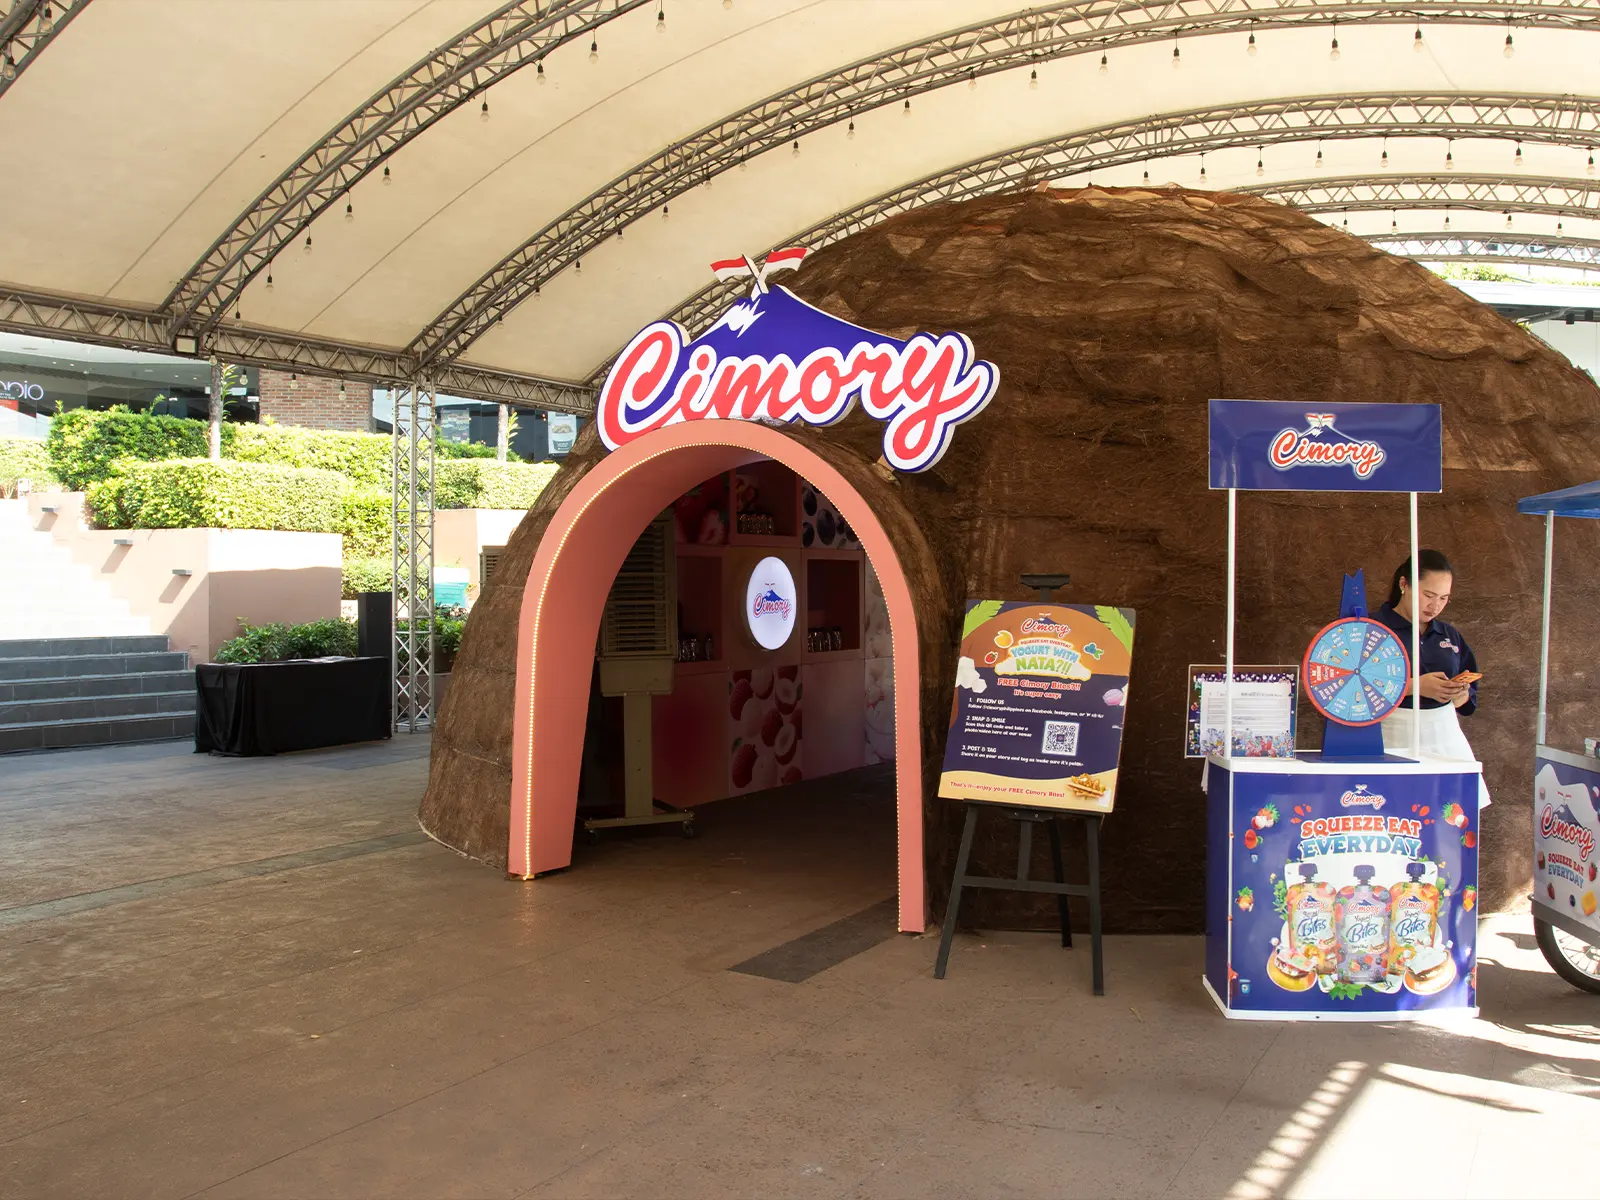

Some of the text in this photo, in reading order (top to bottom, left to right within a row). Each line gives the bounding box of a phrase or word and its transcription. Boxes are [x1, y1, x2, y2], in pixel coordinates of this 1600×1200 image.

[599, 325, 988, 467] Cimory
[1270, 428, 1384, 477] Cimory
[753, 593, 791, 620] Cimory
[1021, 618, 1071, 638] Cimory
[1010, 645, 1079, 663] YOGURT WITH
[1015, 656, 1073, 675] NATA?!!
[997, 678, 1019, 686] FREE
[1020, 679, 1050, 690] Cimory
[1025, 690, 1044, 698] super
[1342, 791, 1384, 809] Cimory
[1301, 816, 1421, 838] SQUEEZE EAT
[1541, 804, 1595, 861] Cimory
[1302, 836, 1421, 859] EVERYDAY
[1548, 853, 1585, 876] SQUEEZE EAT
[1548, 864, 1585, 889] EVERYDAY
[1348, 902, 1380, 914] Cimory
[1398, 899, 1428, 912] Cimory
[1346, 922, 1379, 943] Bites
[1395, 918, 1426, 937] Bites
